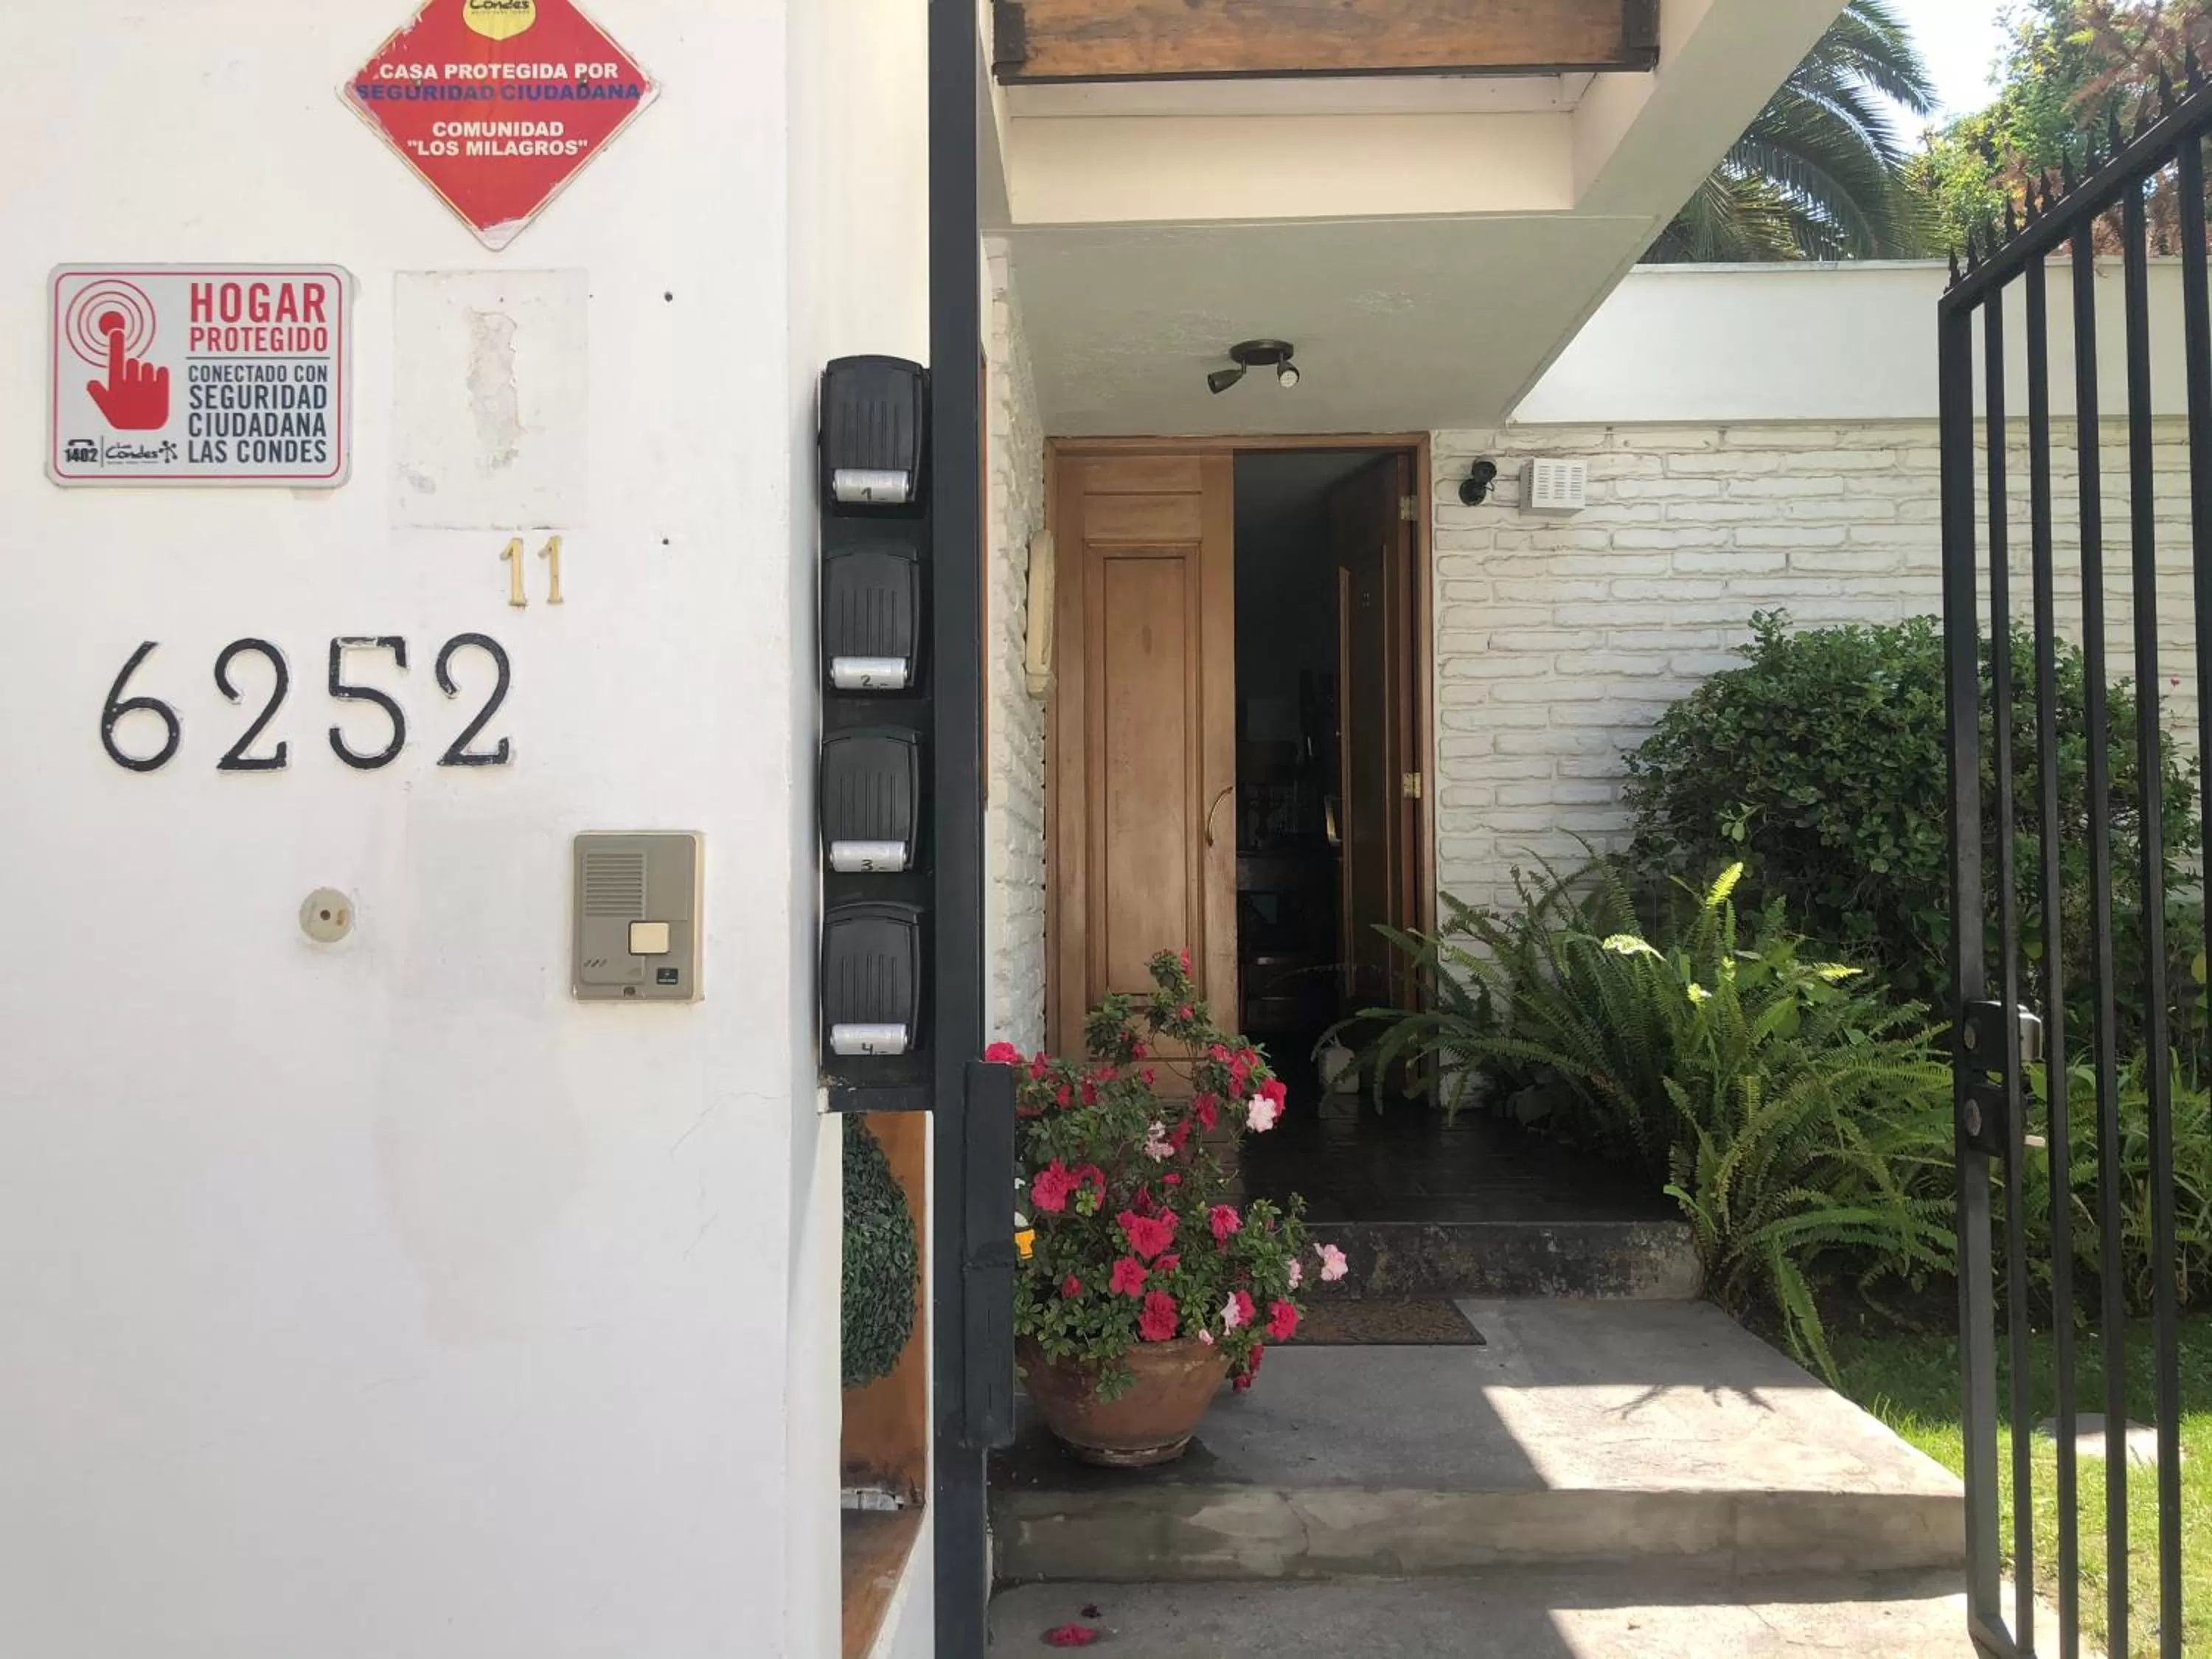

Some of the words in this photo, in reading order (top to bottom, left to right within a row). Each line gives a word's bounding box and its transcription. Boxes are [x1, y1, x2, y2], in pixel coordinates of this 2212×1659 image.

[379, 63, 437, 80] CASA
[445, 63, 568, 80] PROTEGIDA
[574, 63, 618, 79] POR
[355, 85, 495, 101] SEGURIDAD
[500, 83, 641, 100] CIUDADANA
[432, 122, 563, 137] COMUNIDAD
[408, 140, 459, 156] "LOS
[466, 140, 588, 156] MILAGROS"
[189, 282, 326, 323] HOGAR
[189, 327, 328, 352] PROTEGIDO
[188, 365, 287, 383] CONECTADO
[294, 365, 327, 382] CON
[189, 385, 327, 409] SEGURIDAD
[188, 413, 326, 437] CIUDADANA
[64, 448, 98, 462] 1402
[188, 440, 228, 463] LAS
[237, 440, 327, 463] CONDES
[500, 535, 564, 607] 11
[100, 632, 512, 772] 6252
